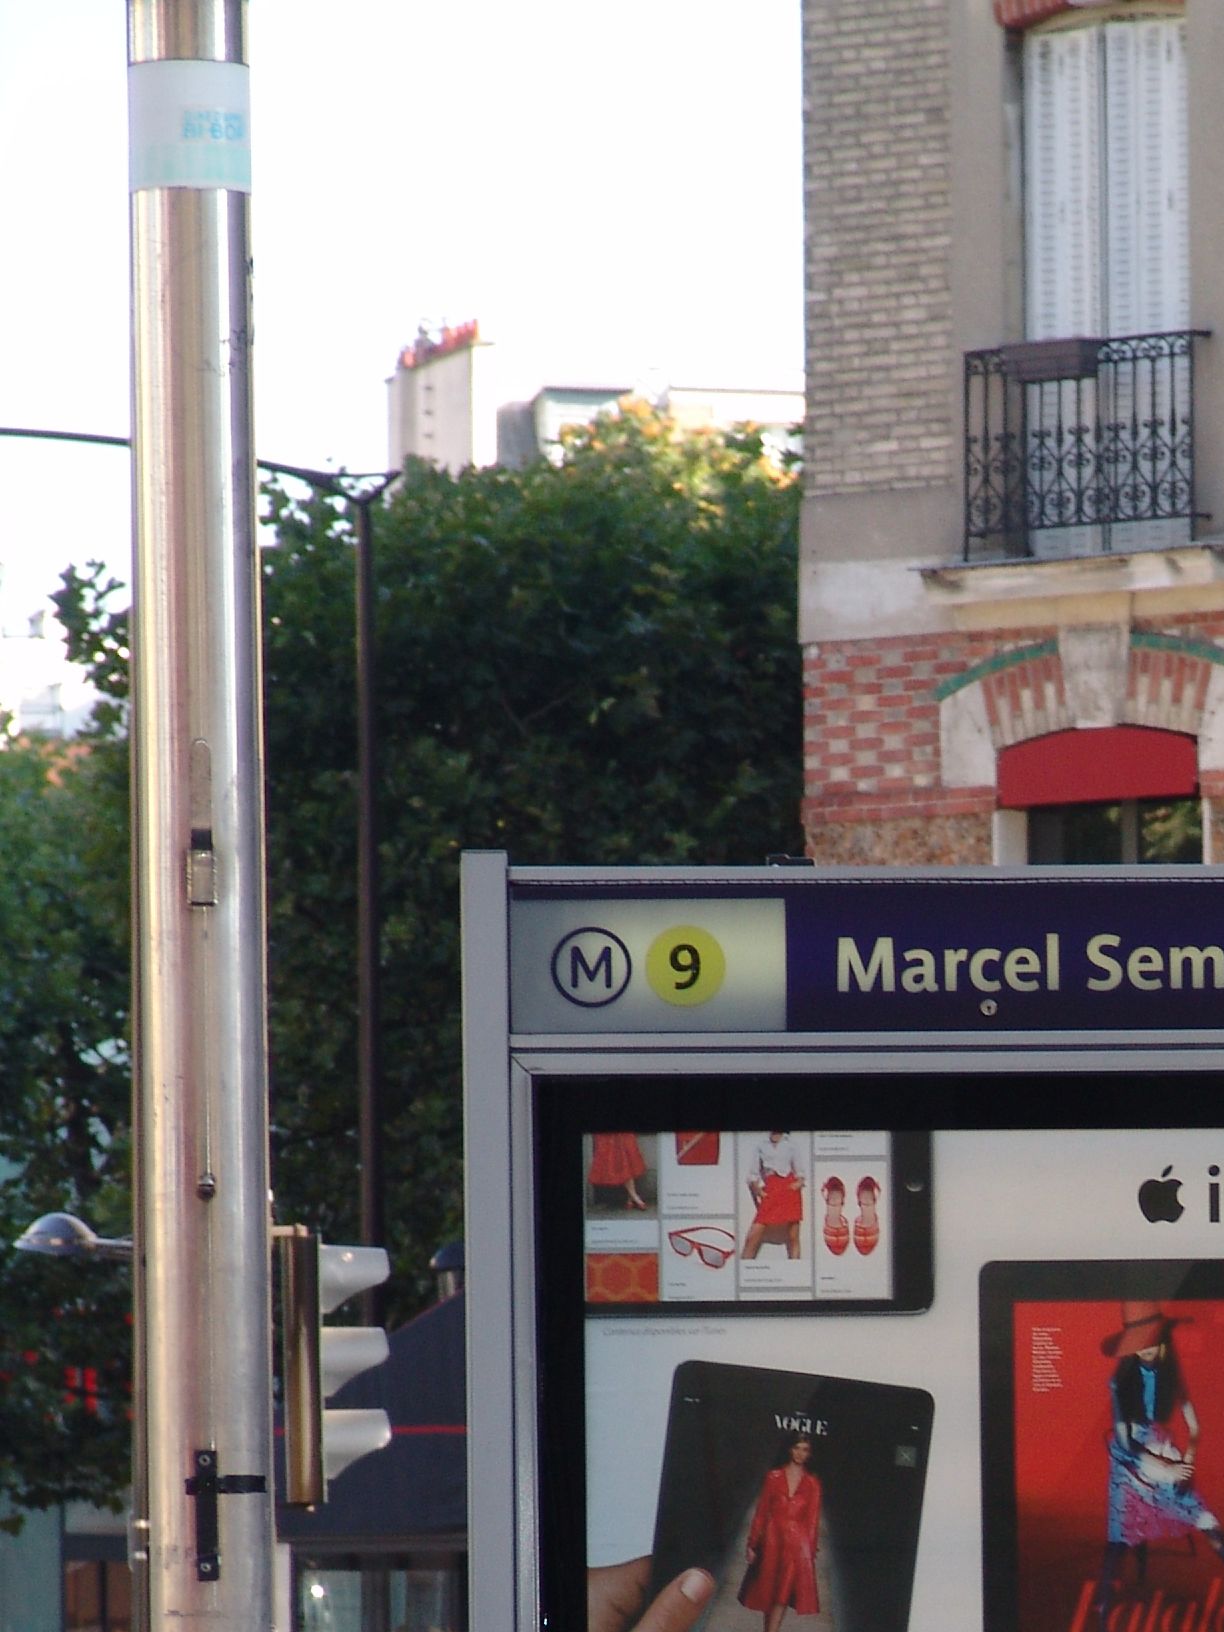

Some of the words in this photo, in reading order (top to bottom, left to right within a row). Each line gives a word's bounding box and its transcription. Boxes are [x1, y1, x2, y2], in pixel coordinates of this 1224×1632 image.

[570, 945, 613, 989] M
[669, 944, 701, 990] 9
[838, 933, 1060, 993] Marcel
[773, 1413, 829, 1436] VOGUE
